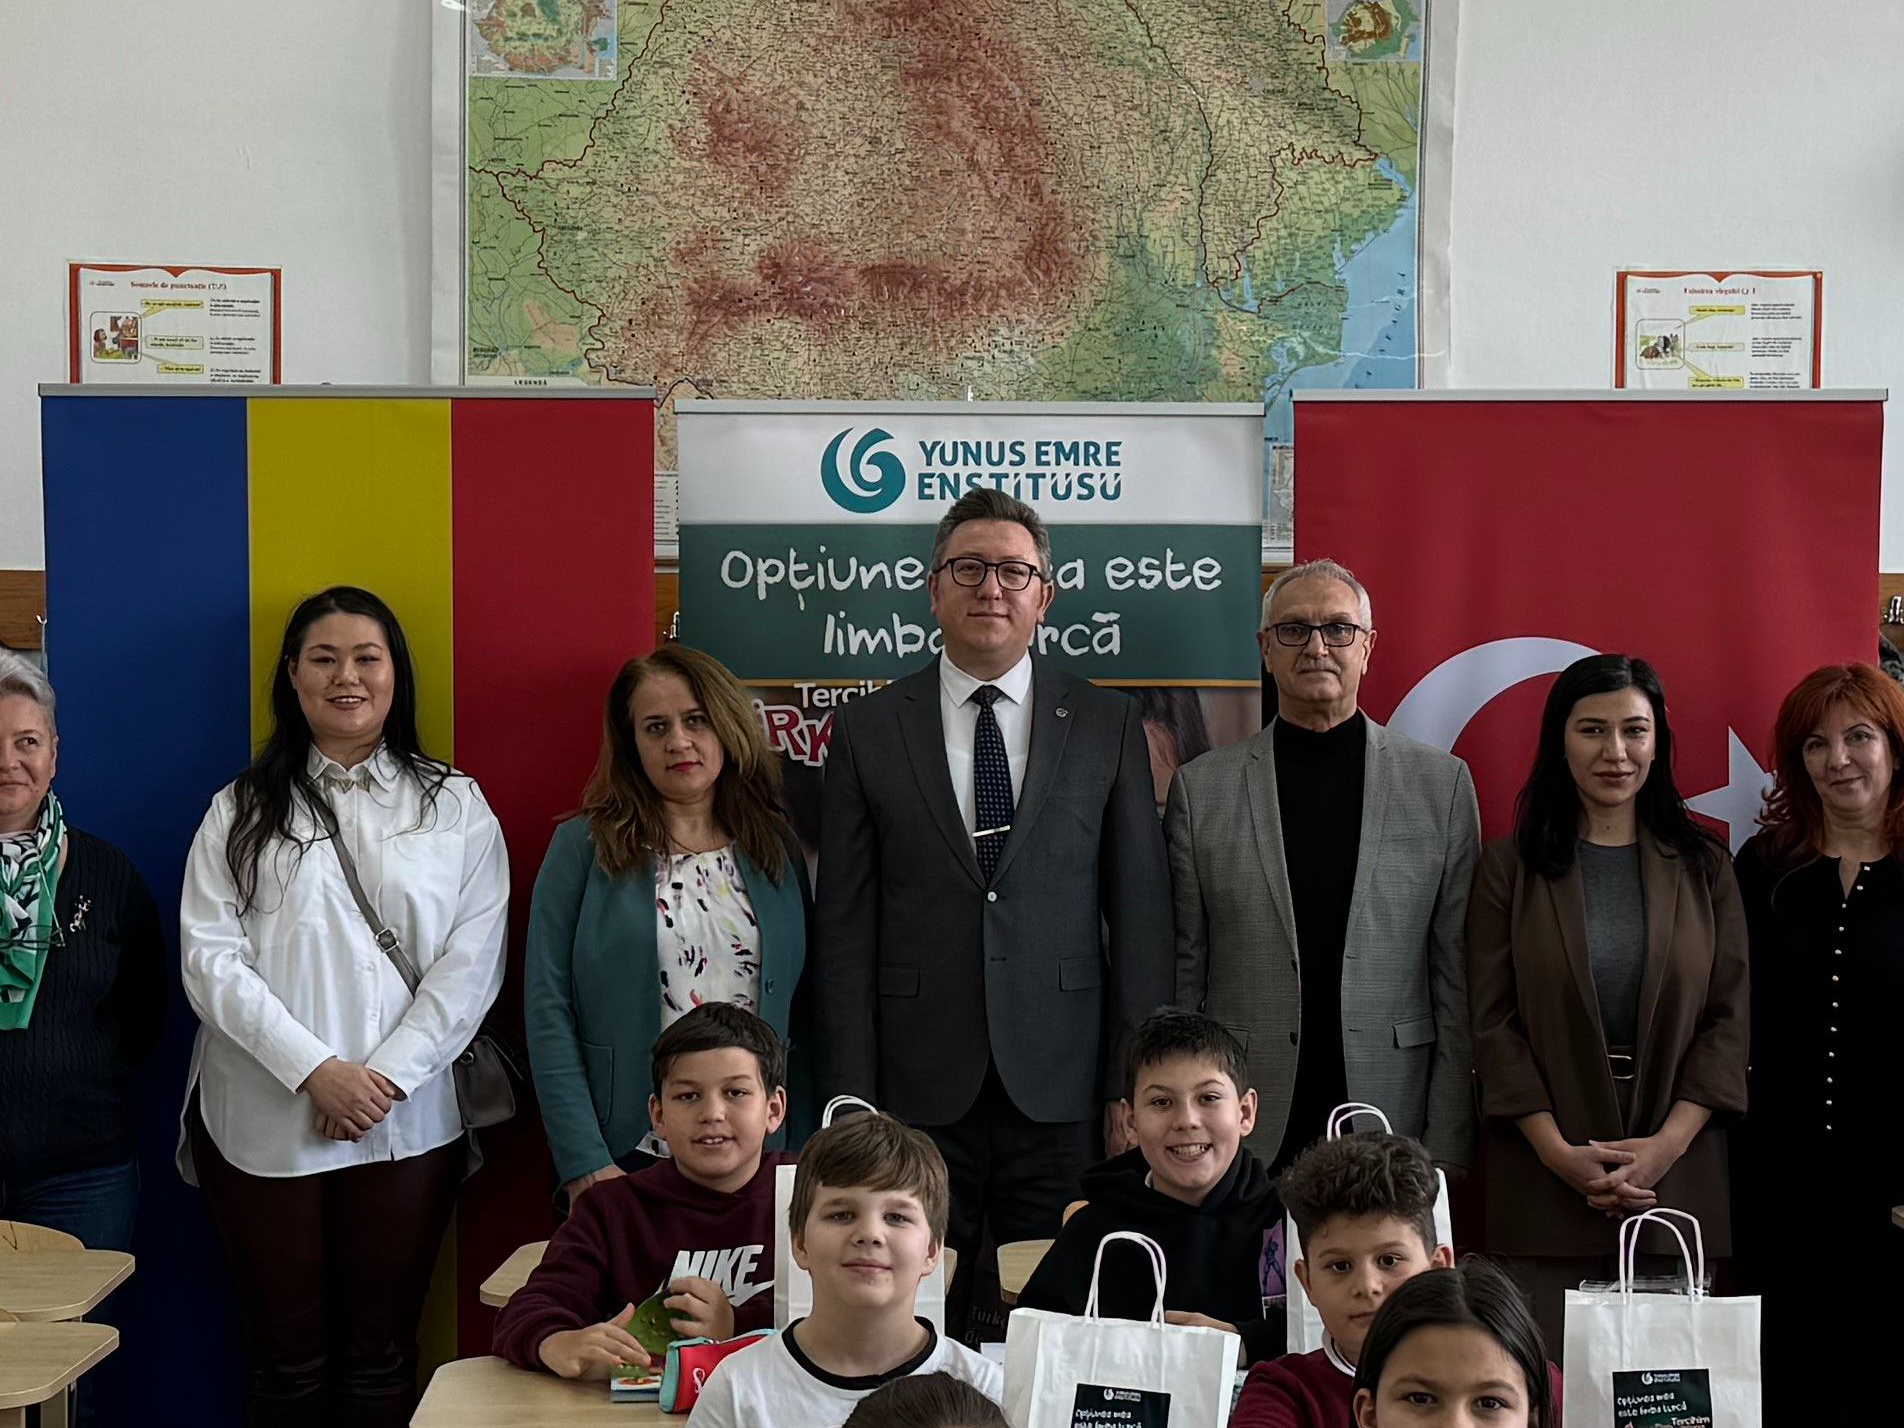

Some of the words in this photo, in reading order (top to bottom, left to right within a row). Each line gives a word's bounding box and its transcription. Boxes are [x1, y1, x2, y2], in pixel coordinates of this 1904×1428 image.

[918, 439, 1026, 467] YUNUS
[1035, 440, 1122, 467] EMRE
[1104, 546, 1222, 592] este
[667, 1244, 764, 1298] NIKE
